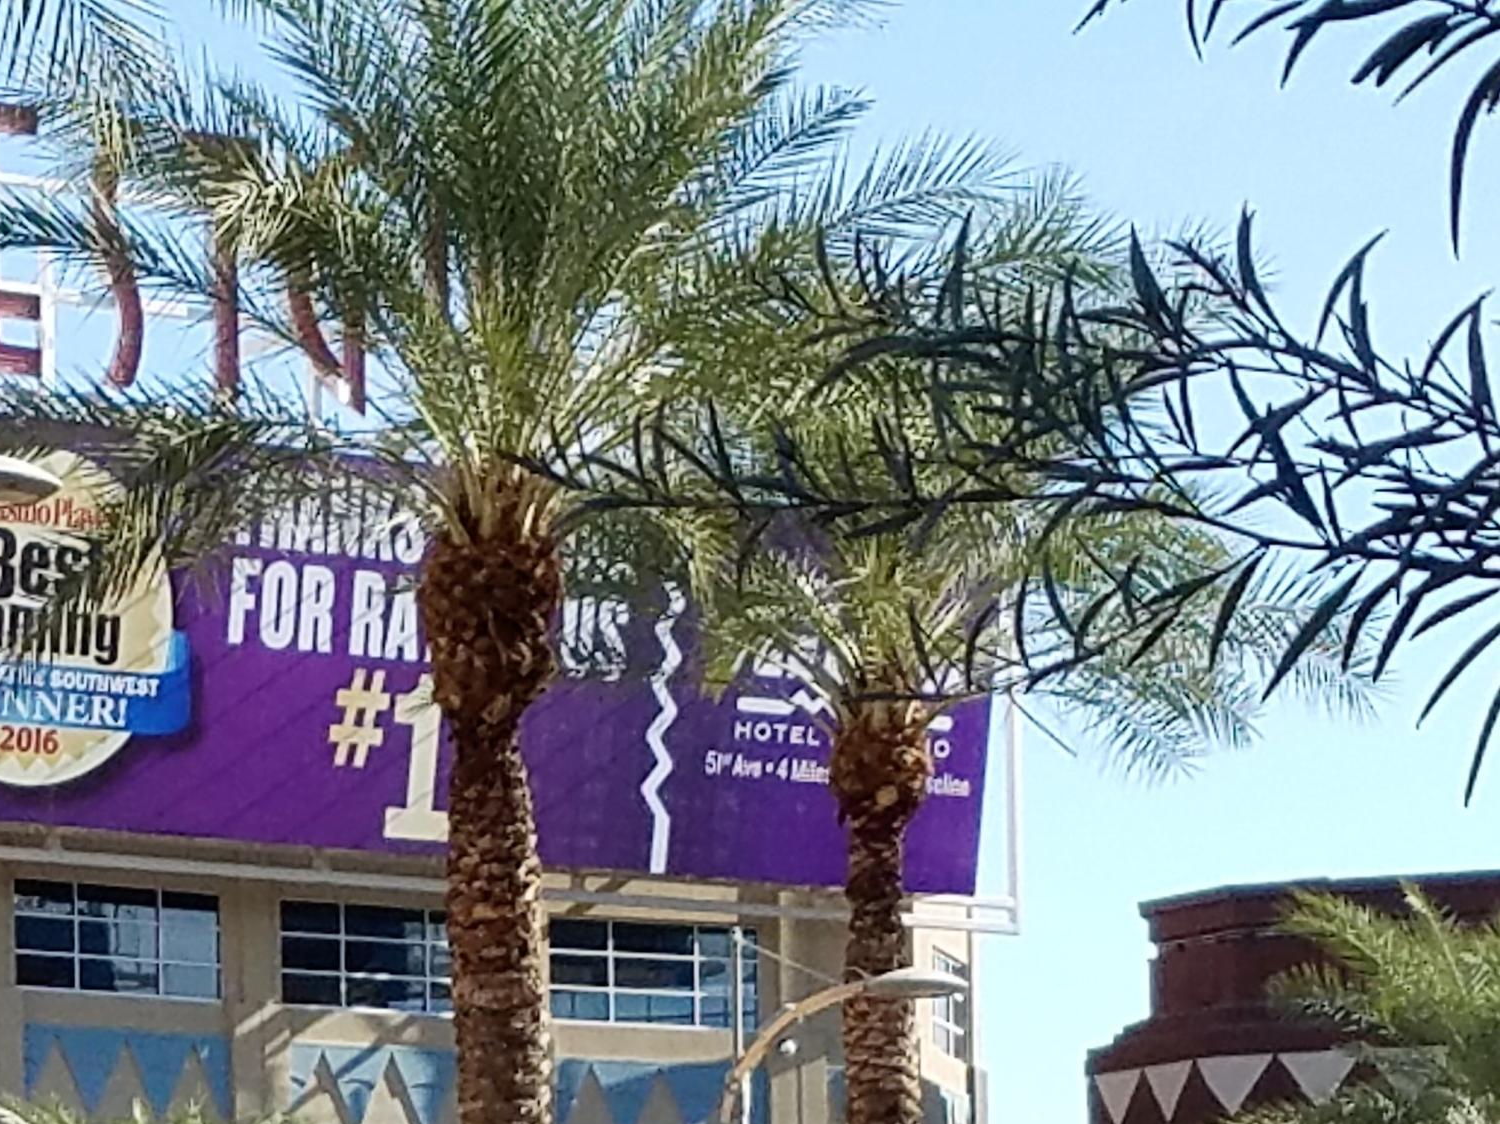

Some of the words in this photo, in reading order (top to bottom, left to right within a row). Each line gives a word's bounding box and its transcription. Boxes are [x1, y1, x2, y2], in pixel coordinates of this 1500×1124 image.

[227, 556, 336, 654] FOR
[51, 670, 160, 698] SOUTHWEST
[733, 720, 821, 747] HOTEL
[329, 667, 451, 843] #1
[775, 757, 789, 781] 4
